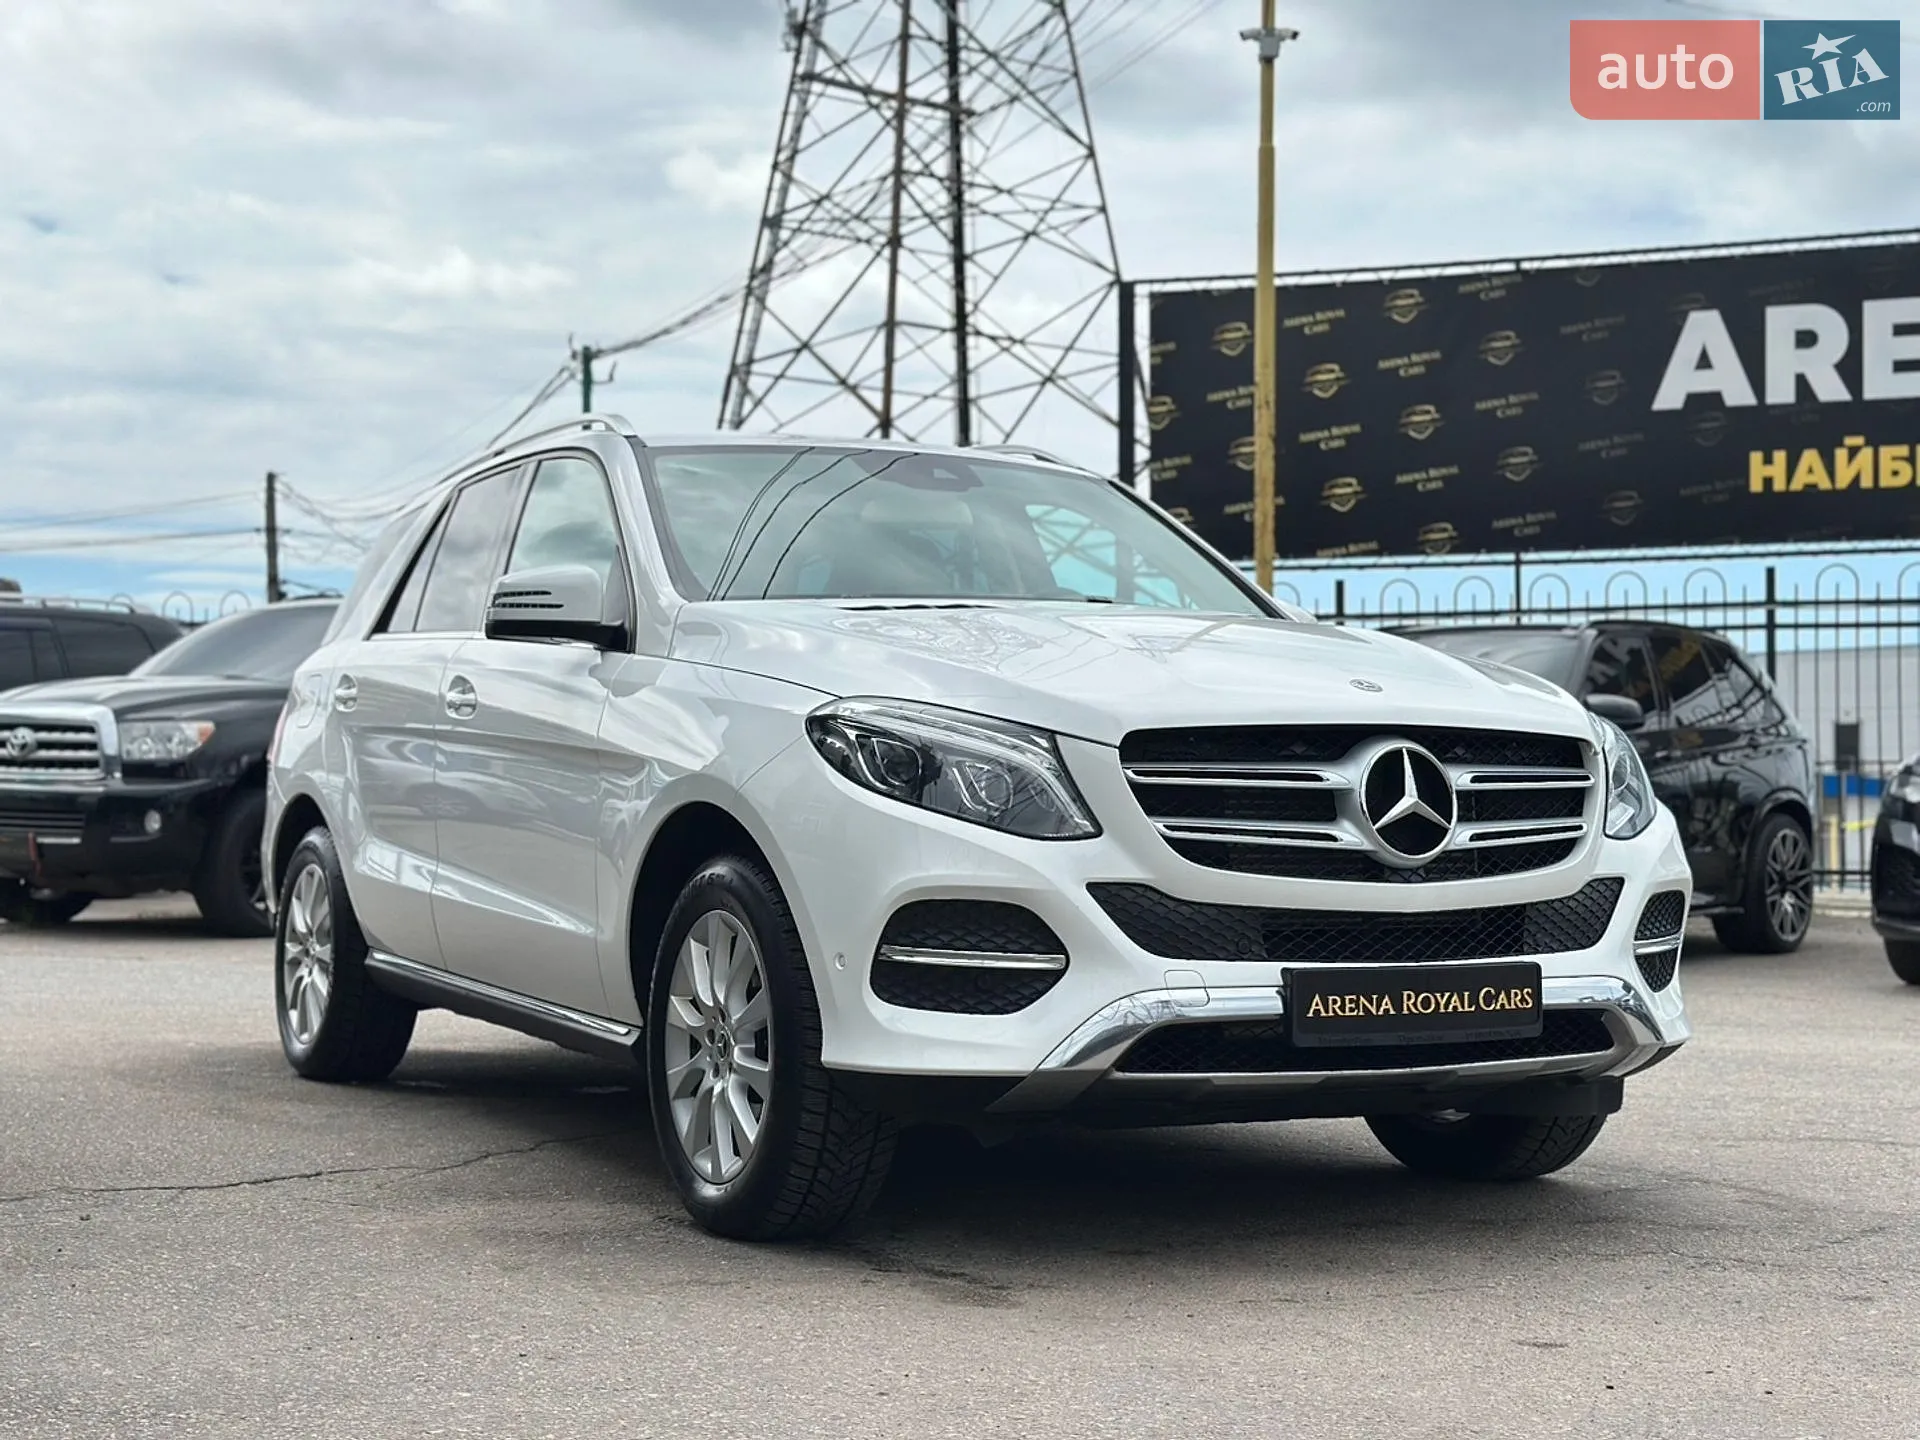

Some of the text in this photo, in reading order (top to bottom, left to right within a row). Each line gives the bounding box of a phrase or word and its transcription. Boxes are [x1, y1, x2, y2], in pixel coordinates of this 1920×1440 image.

[1651, 296, 1920, 412] ARE
[1306, 987, 1533, 1017] ARENA ROYAL CARS
